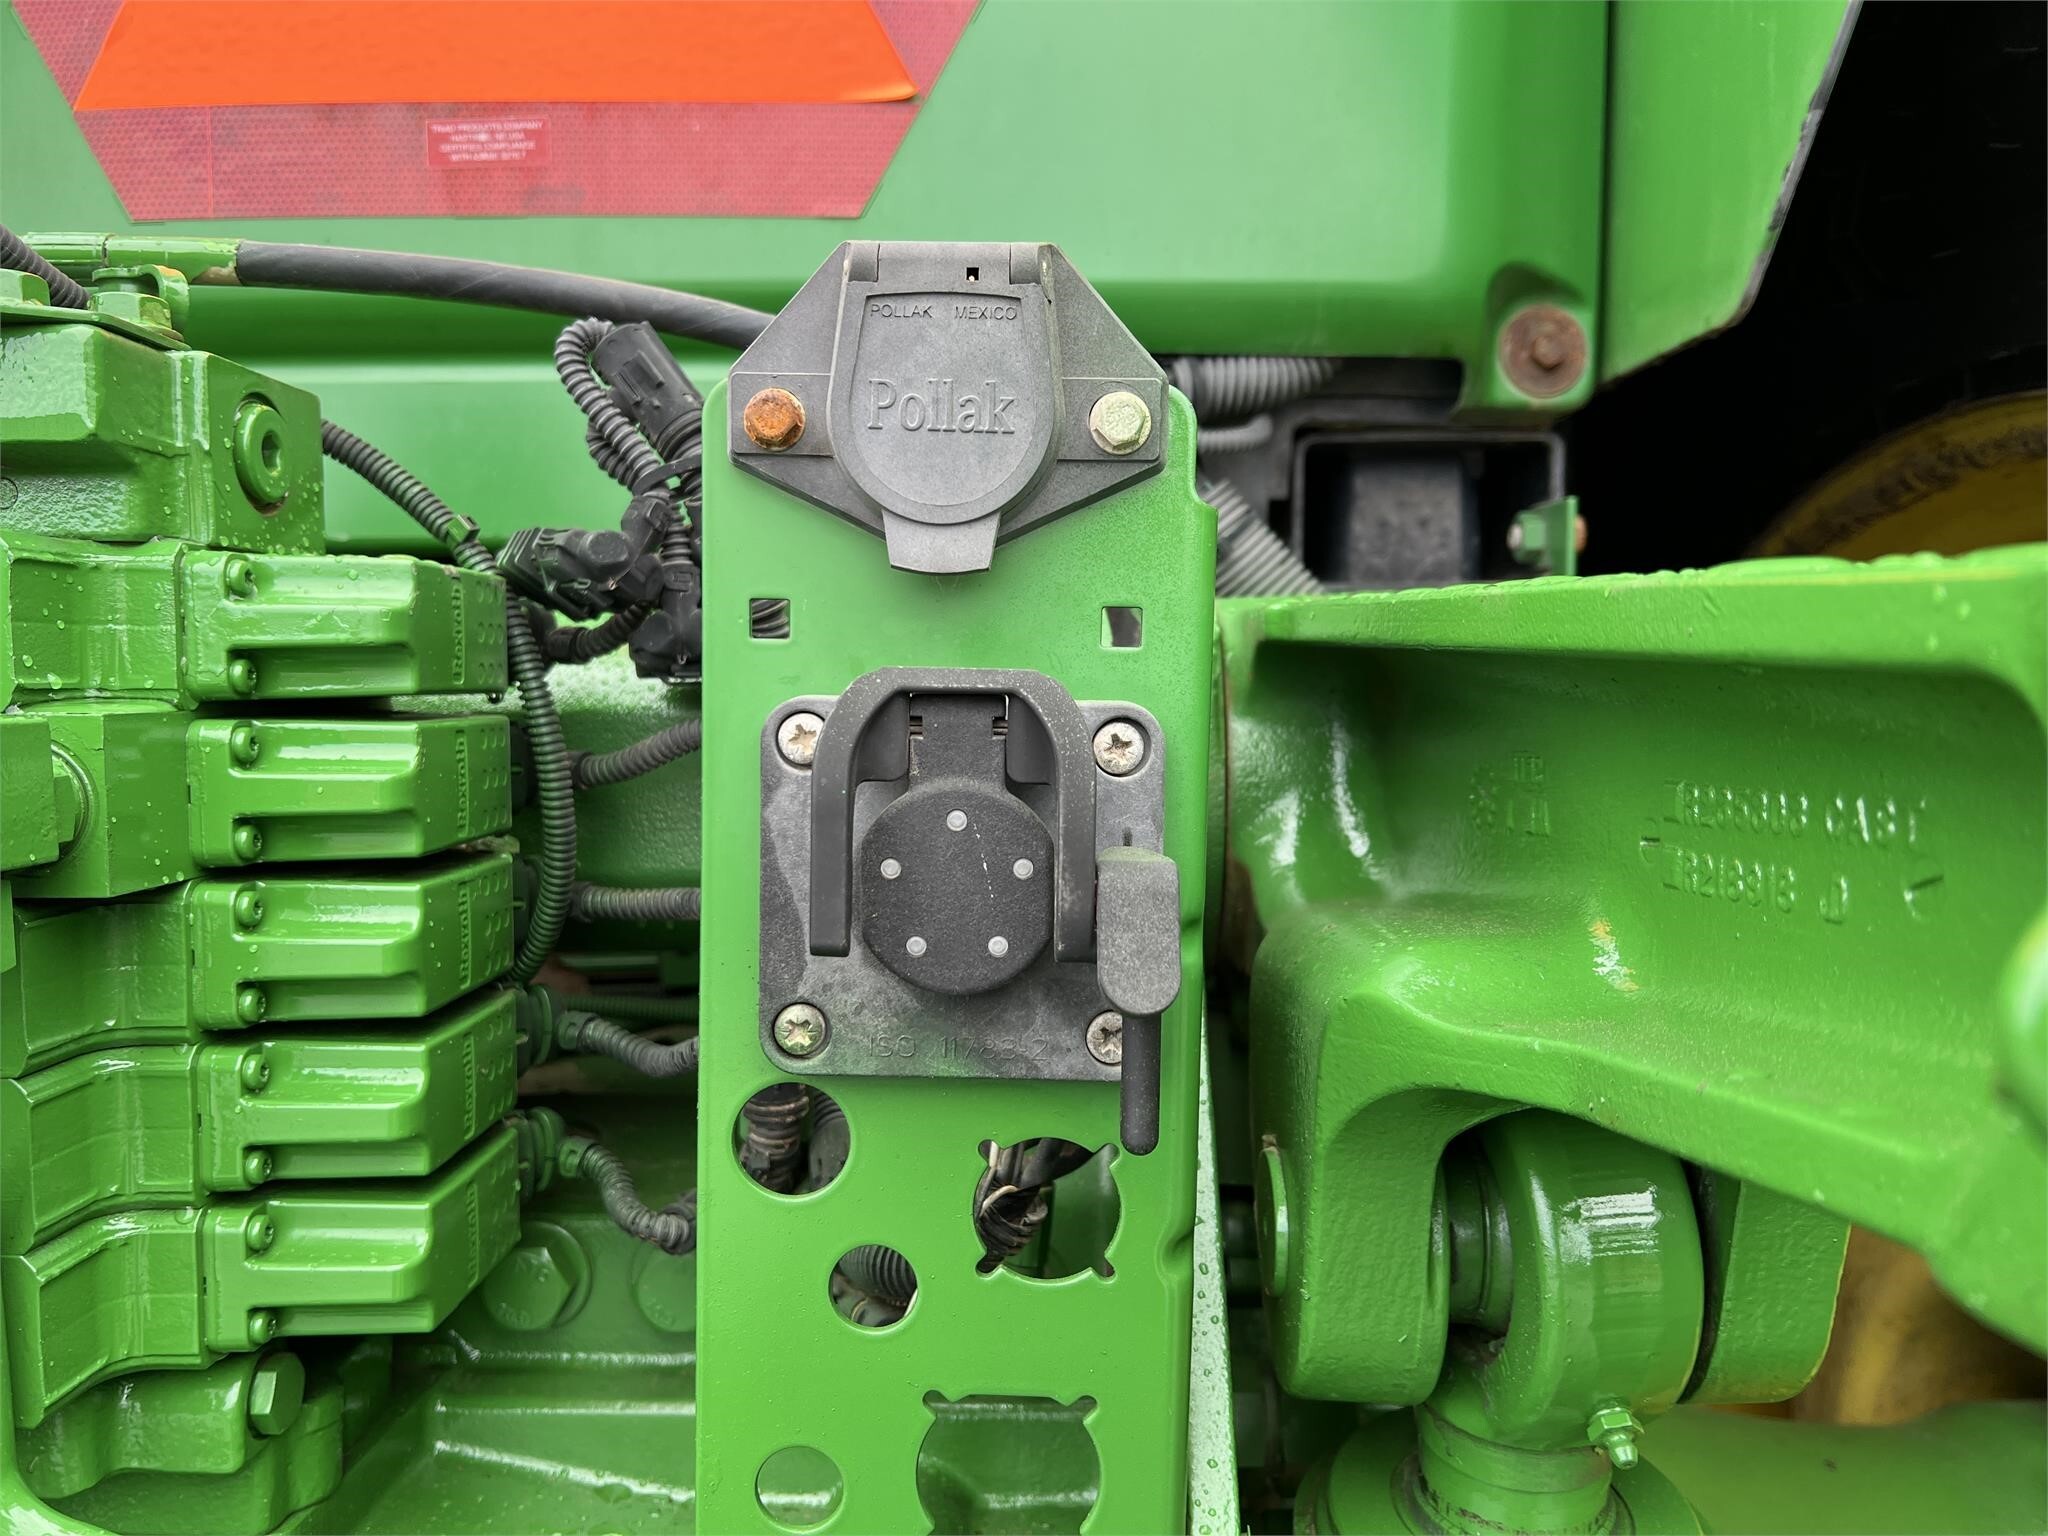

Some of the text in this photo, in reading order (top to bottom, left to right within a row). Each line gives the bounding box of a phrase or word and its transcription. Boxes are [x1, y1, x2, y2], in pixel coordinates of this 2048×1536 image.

[503, 120, 544, 130] COMPANY
[483, 140, 536, 150] COMPLIANCE
[870, 303, 1018, 321] POLLAK MEXICO
[866, 377, 1018, 435] Pollak
[868, 1034, 918, 1058] ISO
